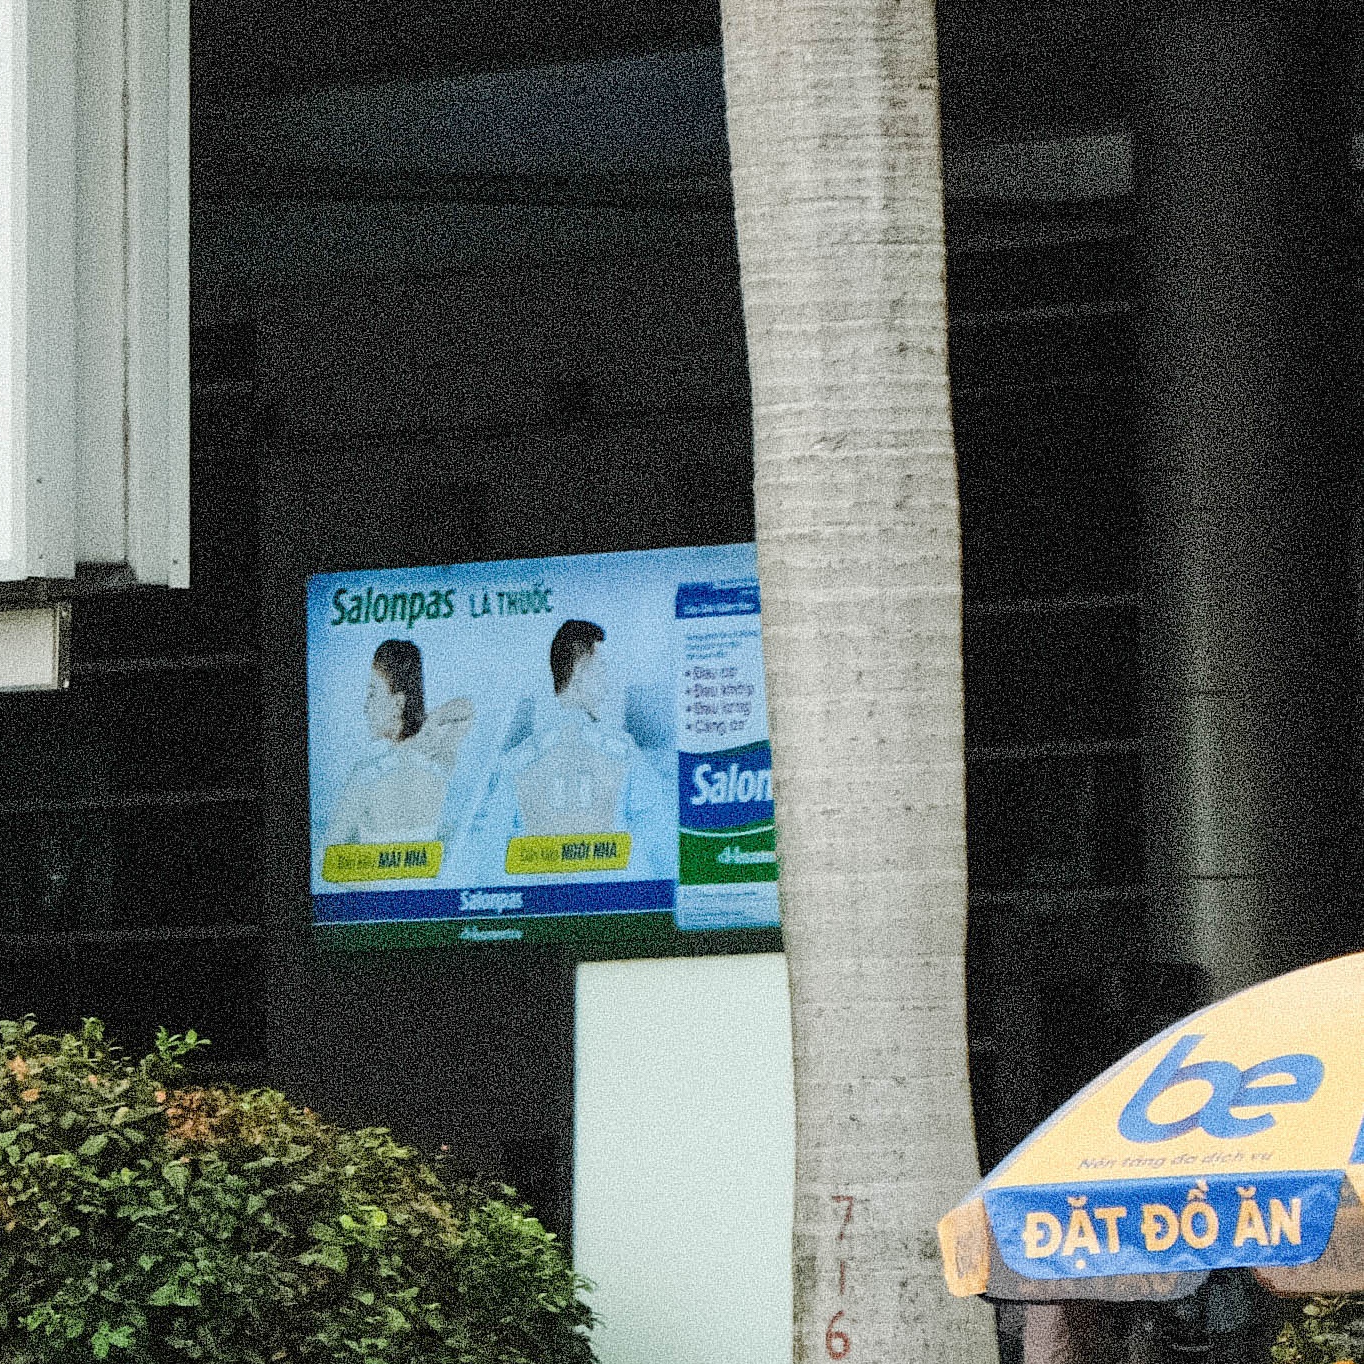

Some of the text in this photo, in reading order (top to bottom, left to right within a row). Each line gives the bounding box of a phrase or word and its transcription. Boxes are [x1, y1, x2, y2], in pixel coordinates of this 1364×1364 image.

[331, 587, 454, 629] Salonpas
[690, 763, 773, 806] Salon
[1117, 1033, 1325, 1144] be
[1022, 1179, 1302, 1270] ĐẶT ĐỒ ĂN
